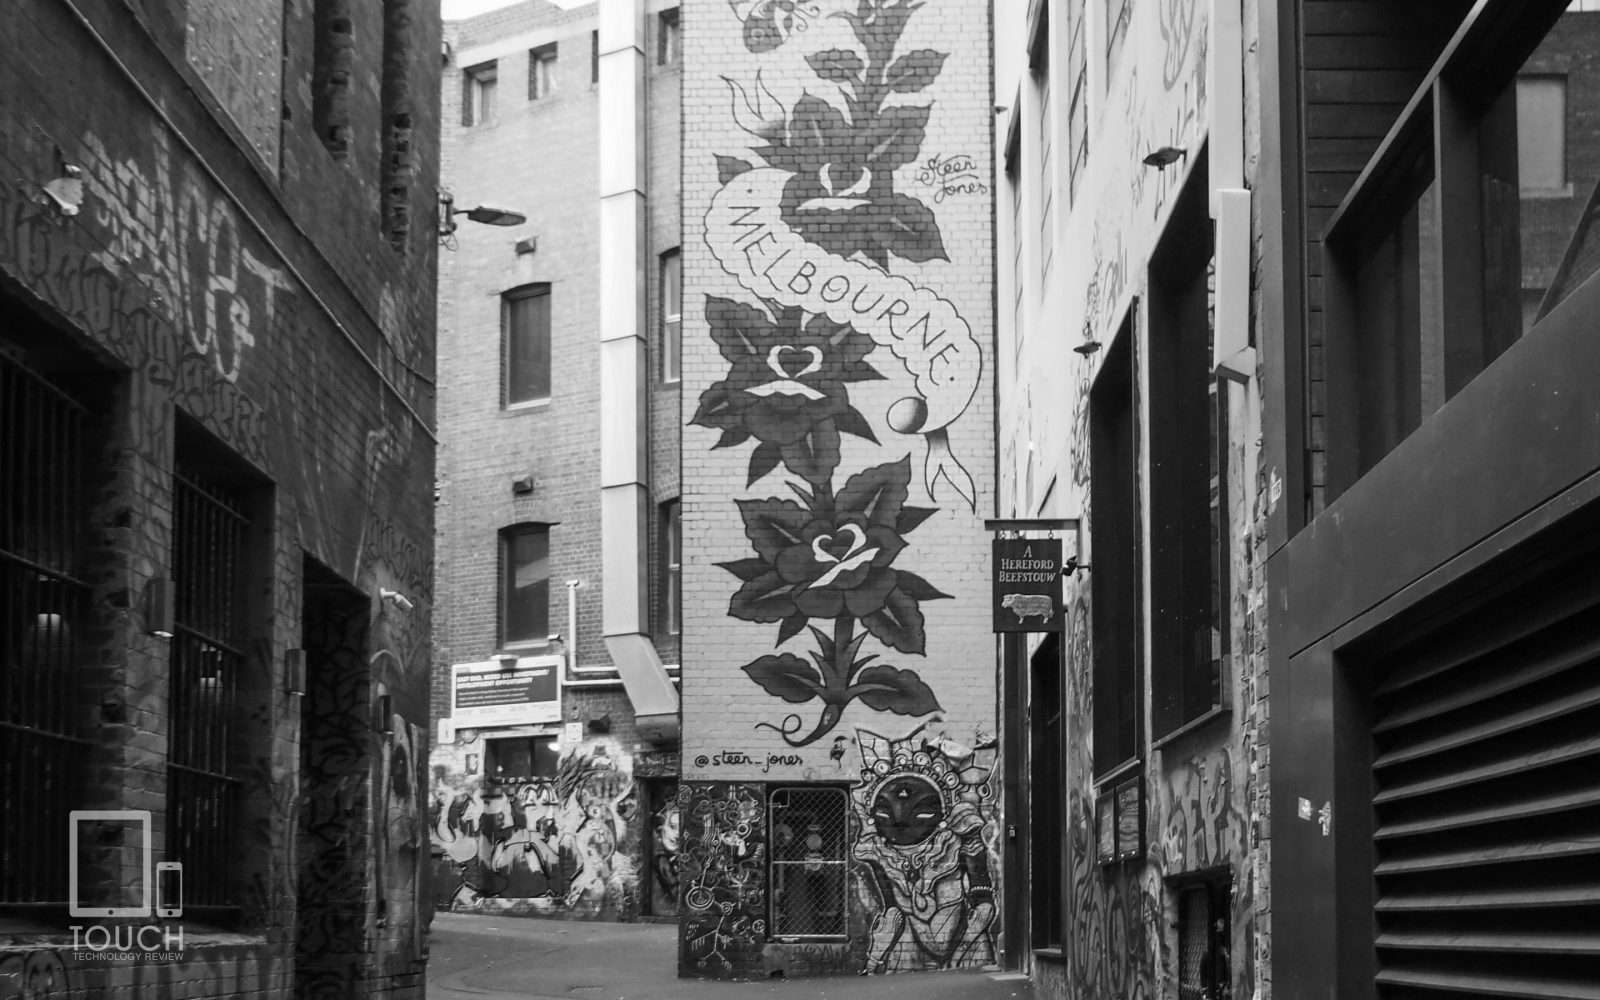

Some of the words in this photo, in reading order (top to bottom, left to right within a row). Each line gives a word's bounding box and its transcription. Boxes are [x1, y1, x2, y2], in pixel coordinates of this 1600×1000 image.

[915, 152, 977, 185] Steen
[728, 206, 960, 386] MELBOURNE
[1023, 544, 1033, 558] A
[1001, 558, 1054, 570] HEREFORD
[999, 570, 1057, 583] BEEFSTOUW
